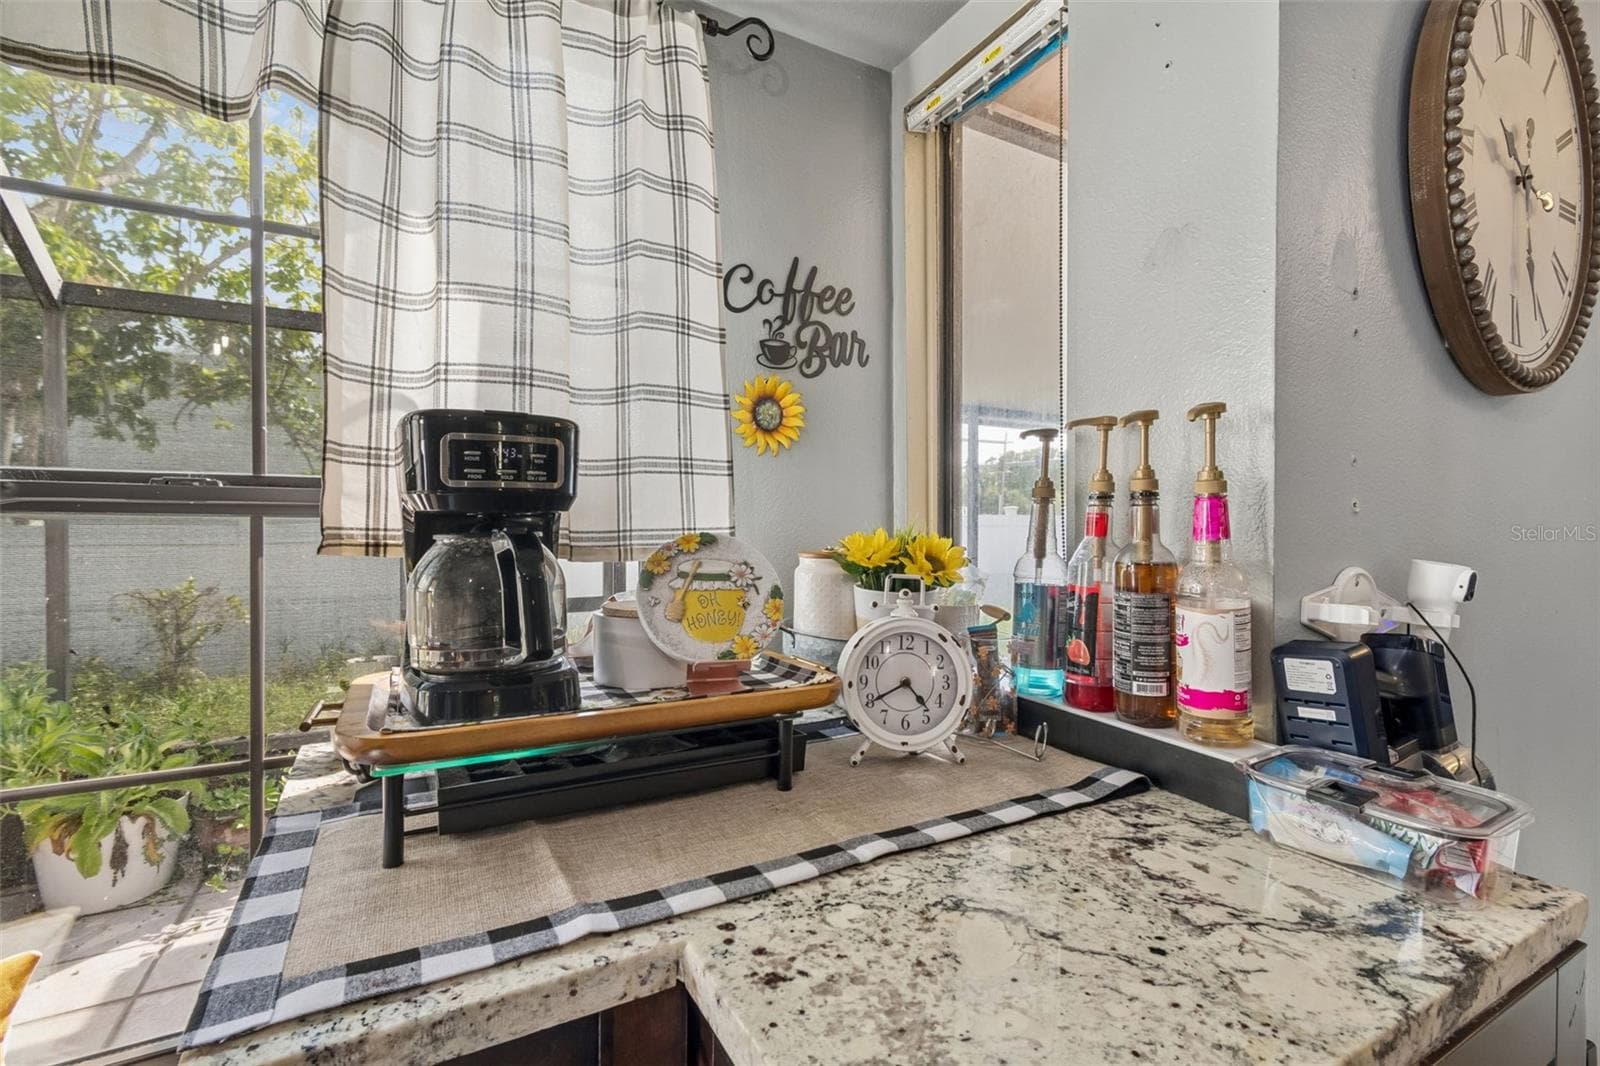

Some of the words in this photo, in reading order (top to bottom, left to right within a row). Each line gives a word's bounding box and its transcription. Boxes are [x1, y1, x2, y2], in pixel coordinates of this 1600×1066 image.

[723, 256, 856, 326] Coffee
[795, 320, 870, 379] Bar
[697, 591, 722, 609] OH
[686, 609, 742, 631] HONEY!
[897, 635, 914, 651] 12
[924, 640, 930, 656] 1
[864, 655, 880, 670] 10
[936, 654, 945, 670] 2
[859, 675, 869, 690] 9
[942, 674, 951, 691] 3
[865, 692, 876, 709] 8
[934, 692, 945, 709] 4
[880, 709, 889, 725] 7
[900, 714, 910, 731] 6
[922, 708, 931, 725] 5
